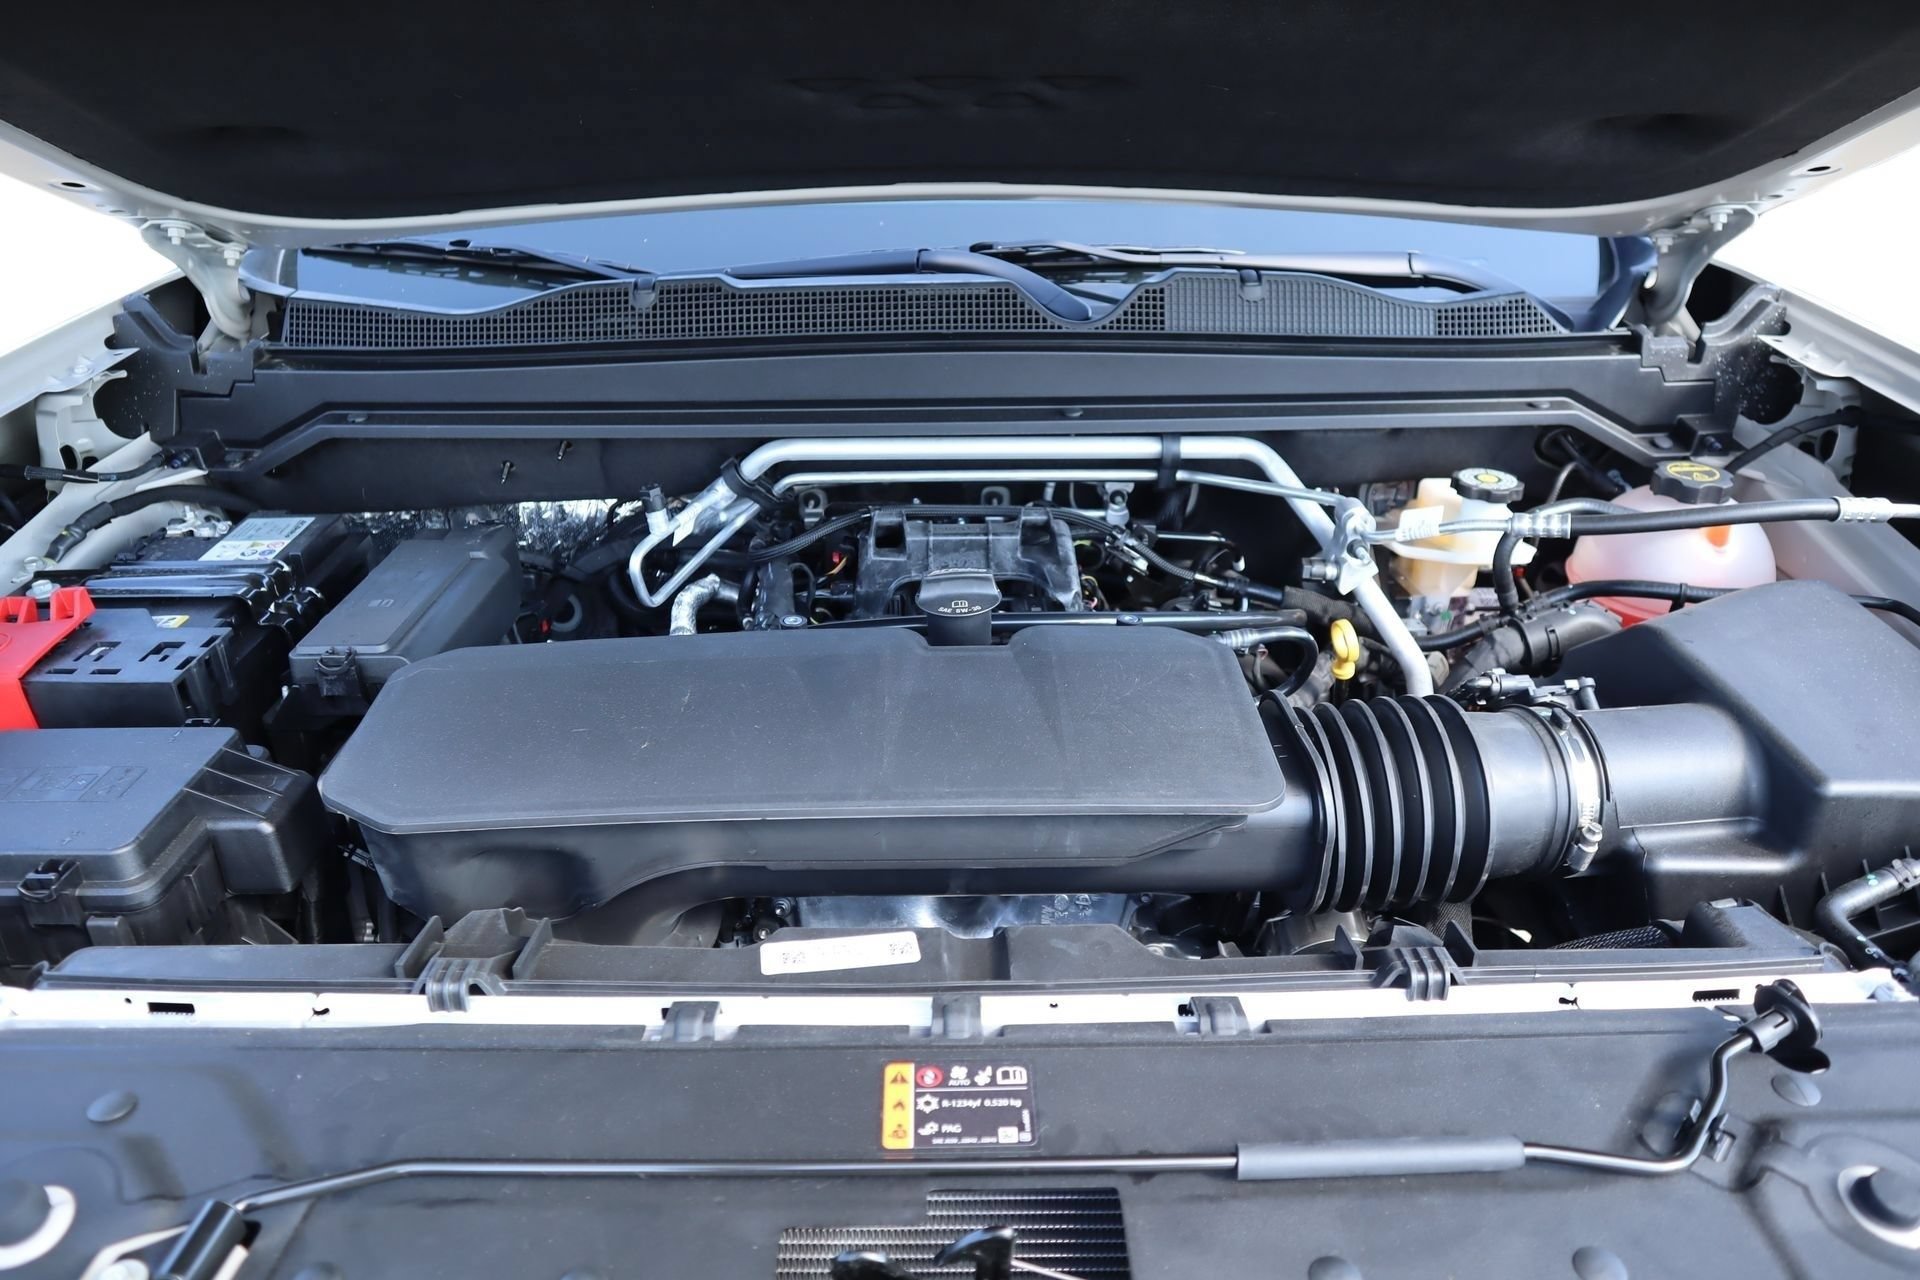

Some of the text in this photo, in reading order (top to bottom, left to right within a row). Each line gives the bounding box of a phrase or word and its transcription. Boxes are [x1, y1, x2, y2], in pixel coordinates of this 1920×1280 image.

[941, 1099, 981, 1108] R-1234yf
[1009, 1098, 1022, 1108] kg
[941, 1124, 962, 1133] PAG
